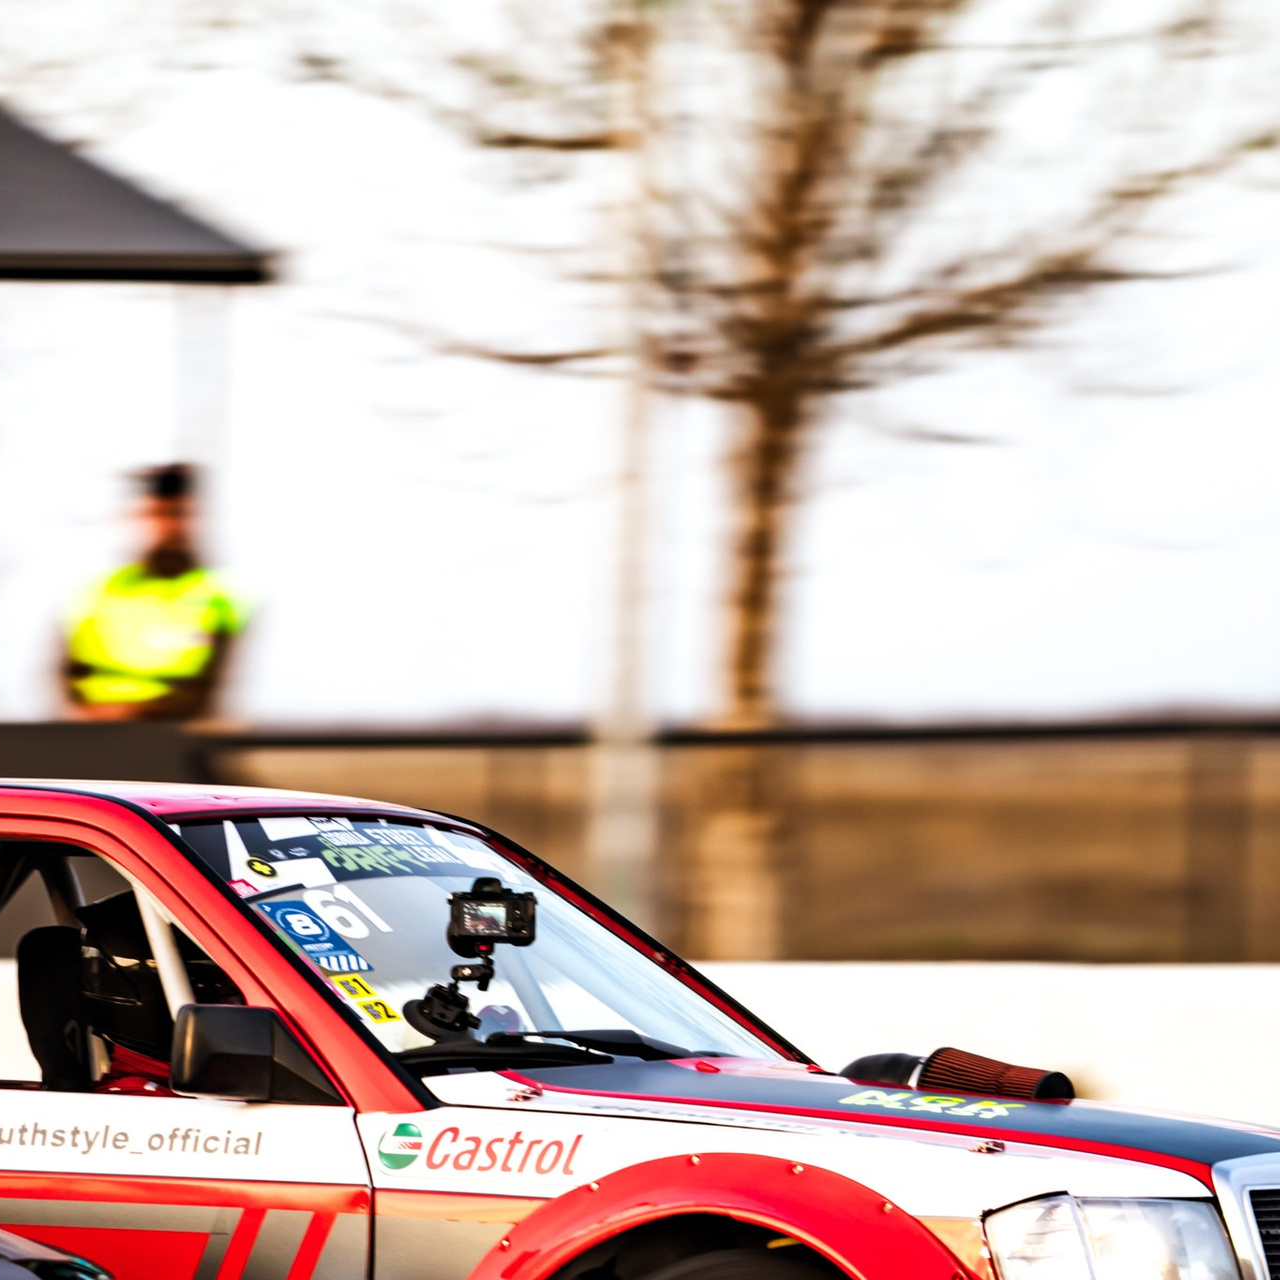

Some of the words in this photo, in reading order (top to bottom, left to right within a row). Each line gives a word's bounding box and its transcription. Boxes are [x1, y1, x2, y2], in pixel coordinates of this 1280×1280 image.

[363, 828, 431, 847] STREET
[403, 845, 465, 864] LEGAL
[303, 884, 394, 939] 61
[425, 1126, 584, 1176] Castrol
